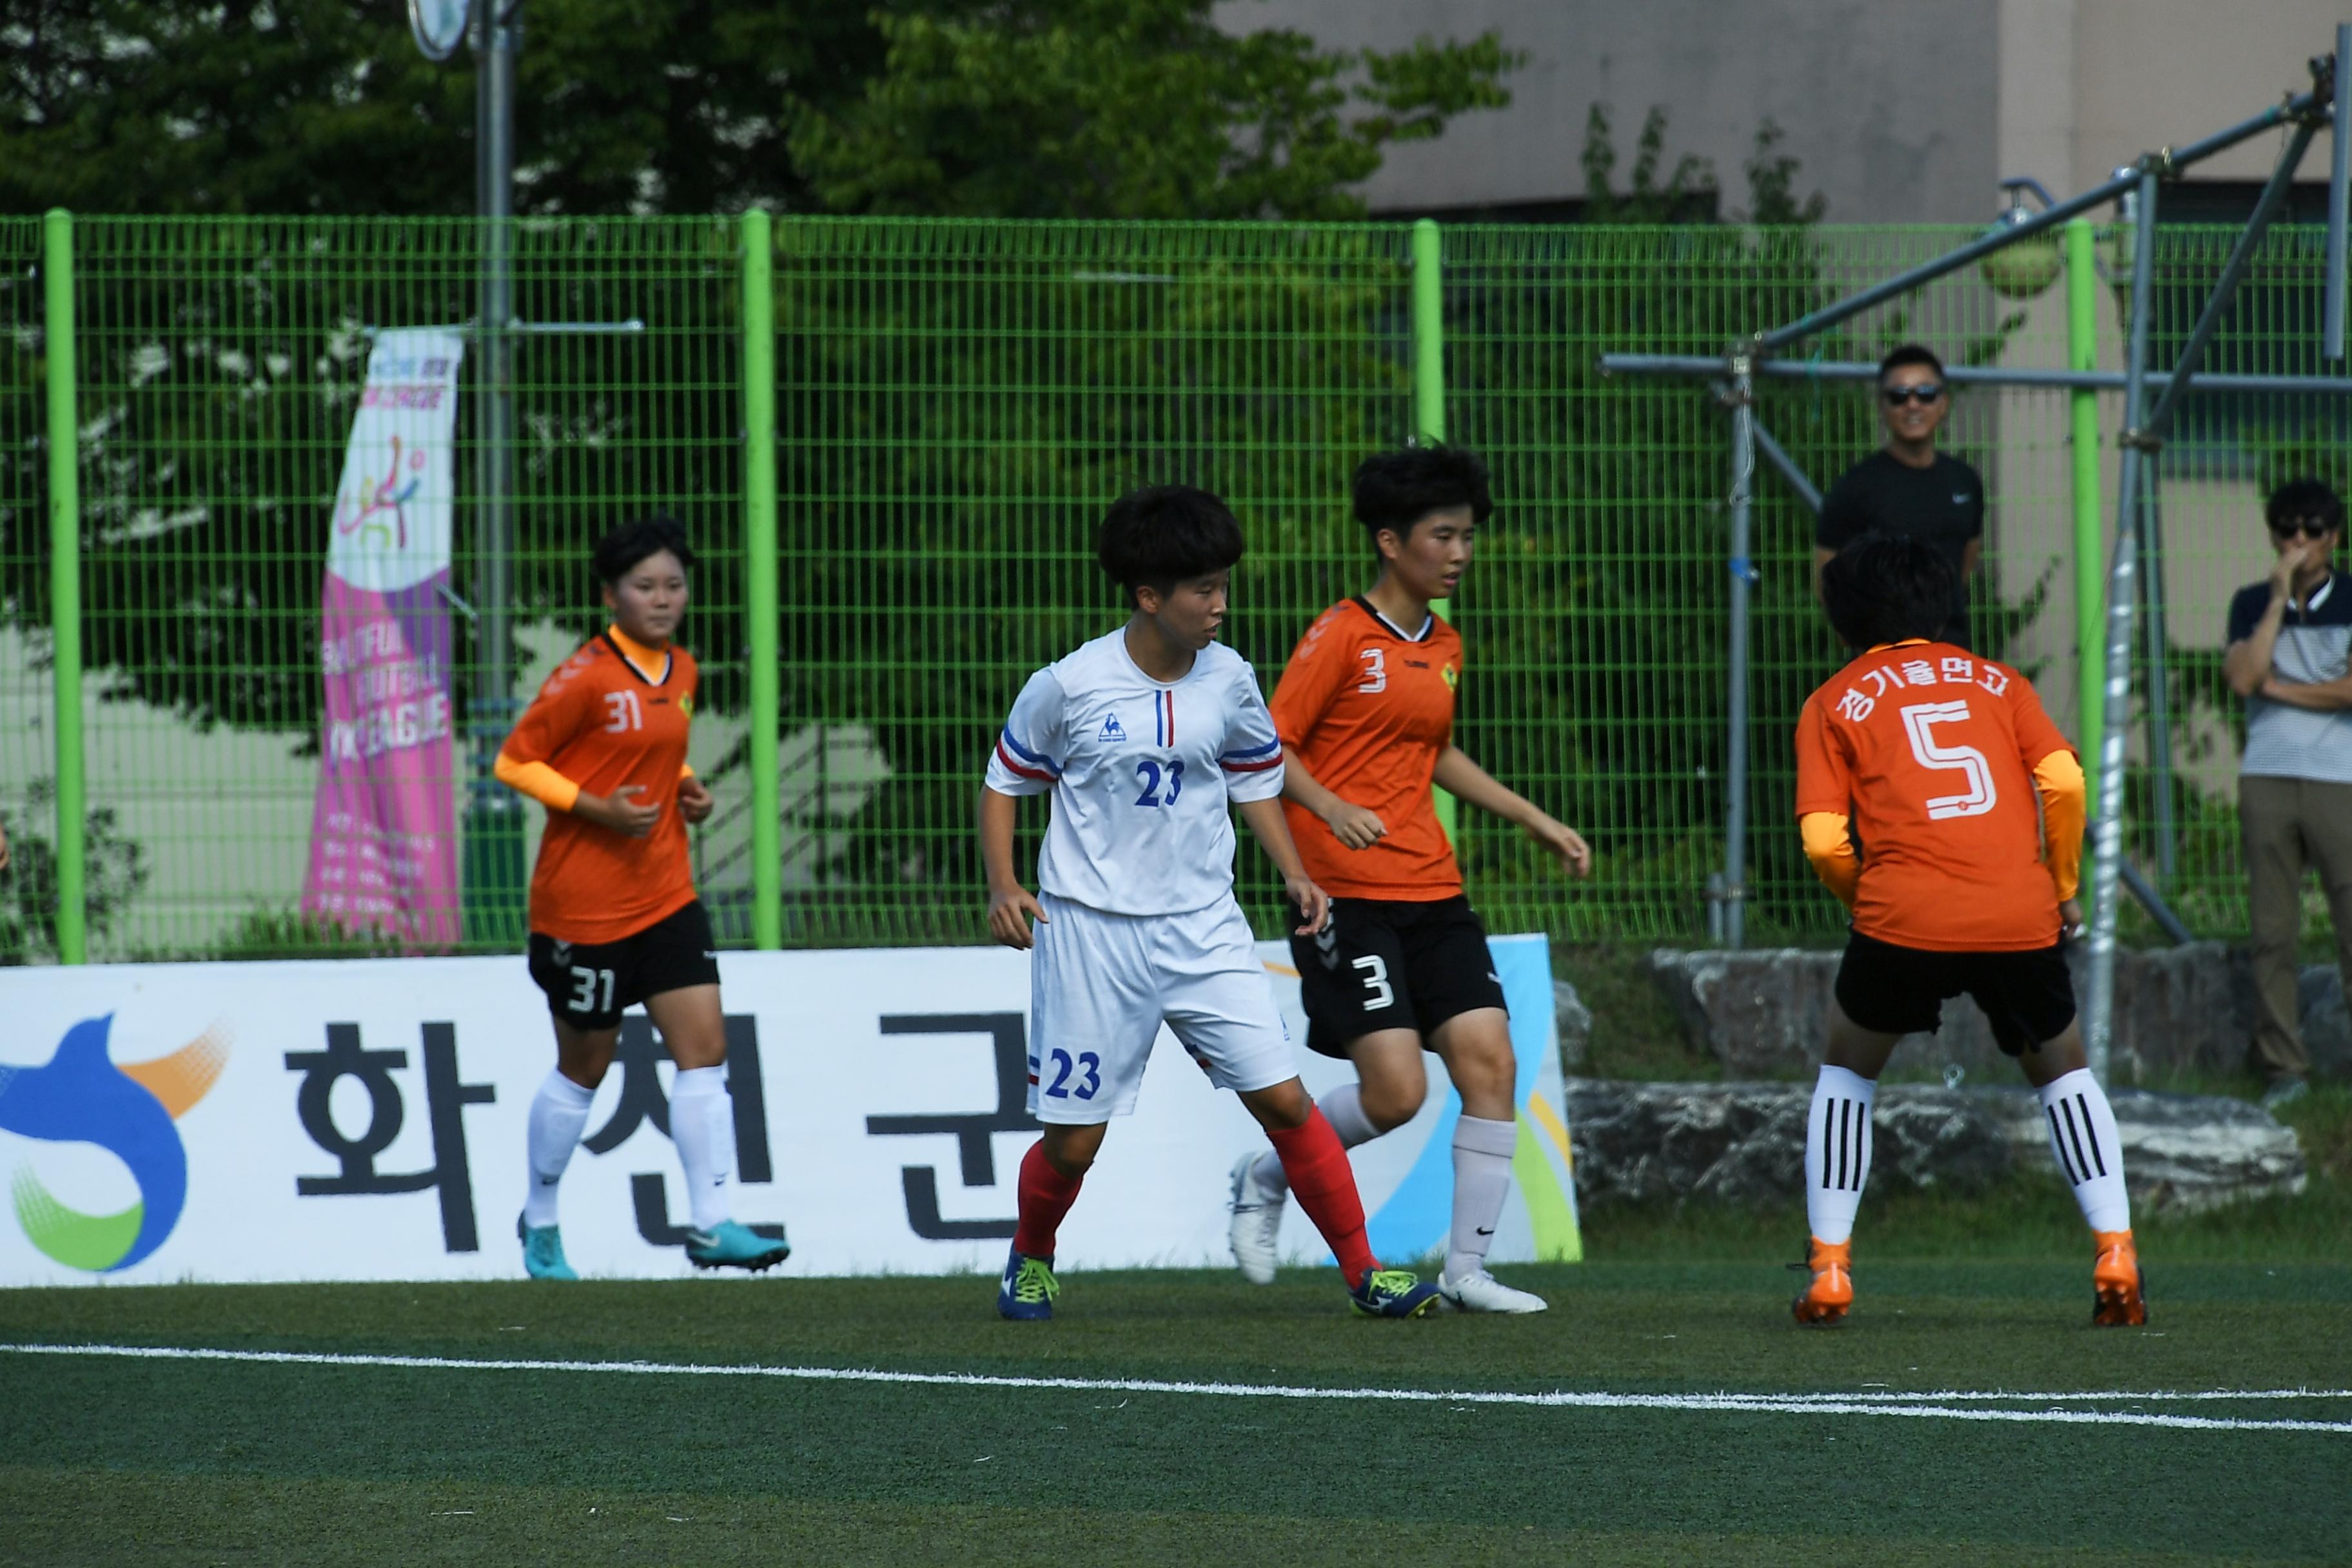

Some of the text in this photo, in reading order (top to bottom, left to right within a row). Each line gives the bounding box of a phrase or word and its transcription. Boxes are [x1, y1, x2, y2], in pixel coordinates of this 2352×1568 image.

[1357, 647, 1387, 694] 3
[603, 689, 643, 734] 31
[1134, 760, 1185, 807] 23
[1899, 699, 1997, 821] 5
[567, 965, 616, 1014] 31
[1351, 954, 1395, 1012] 3
[1045, 1048, 1101, 1101] 23
